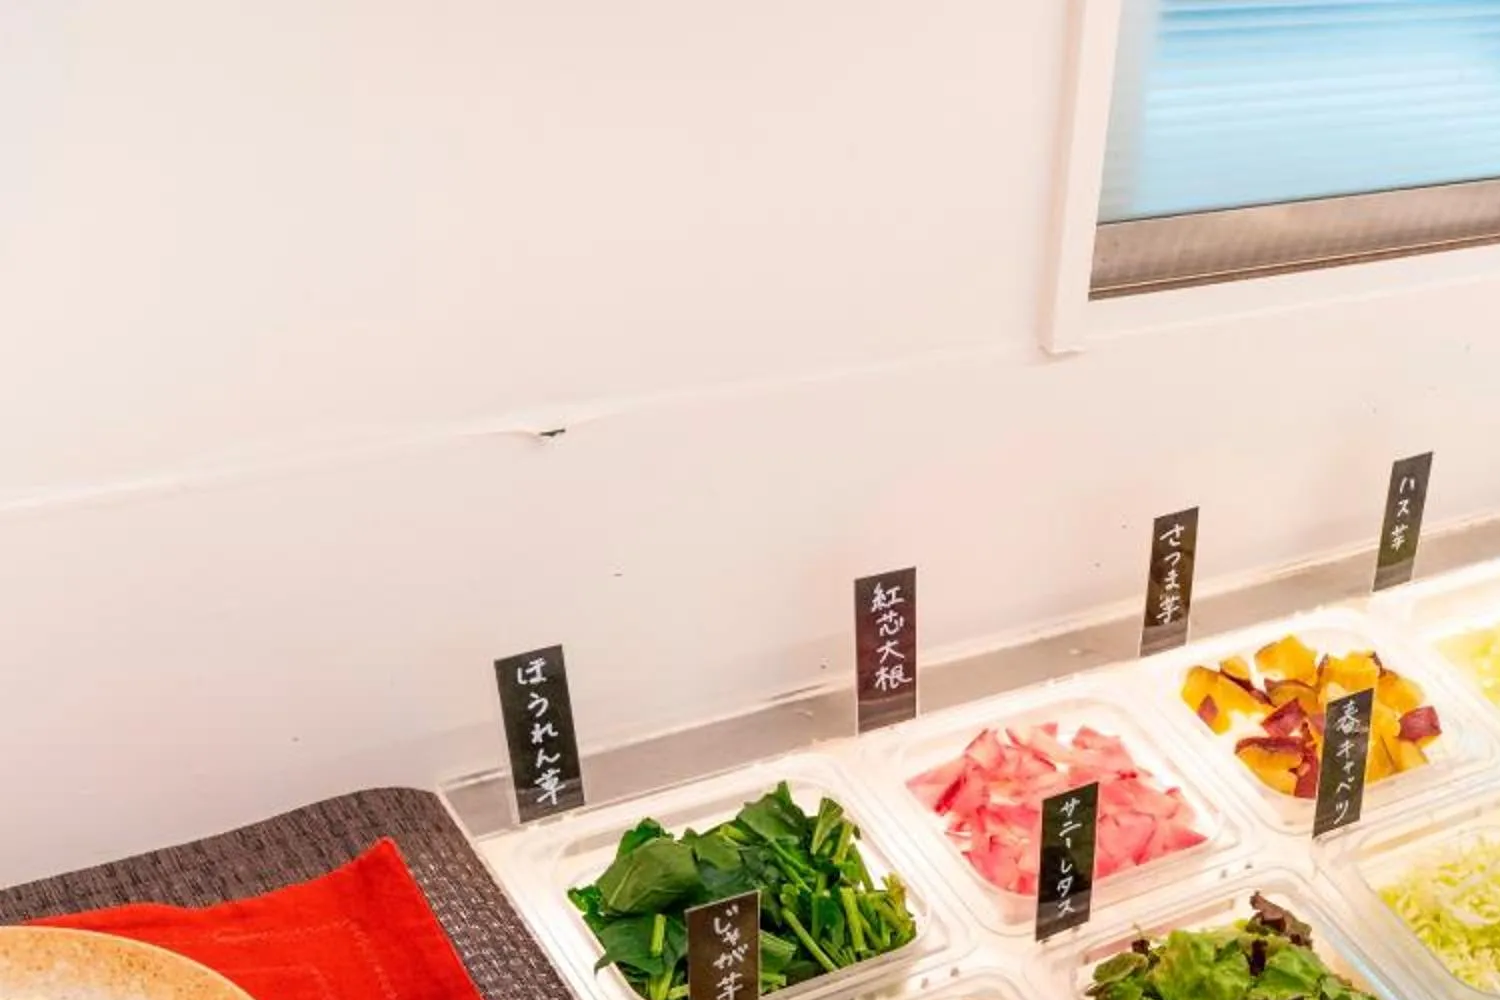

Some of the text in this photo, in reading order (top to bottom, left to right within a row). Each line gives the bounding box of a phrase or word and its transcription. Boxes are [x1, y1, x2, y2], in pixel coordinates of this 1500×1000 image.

[1390, 476, 1416, 552] ハス芋
[1155, 523, 1185, 625] さつま芋
[870, 582, 913, 692] 紅芯大根
[516, 657, 567, 805] ほうれん草
[1333, 699, 1362, 825] 春キャベツ
[1056, 797, 1083, 918] サニーレタス
